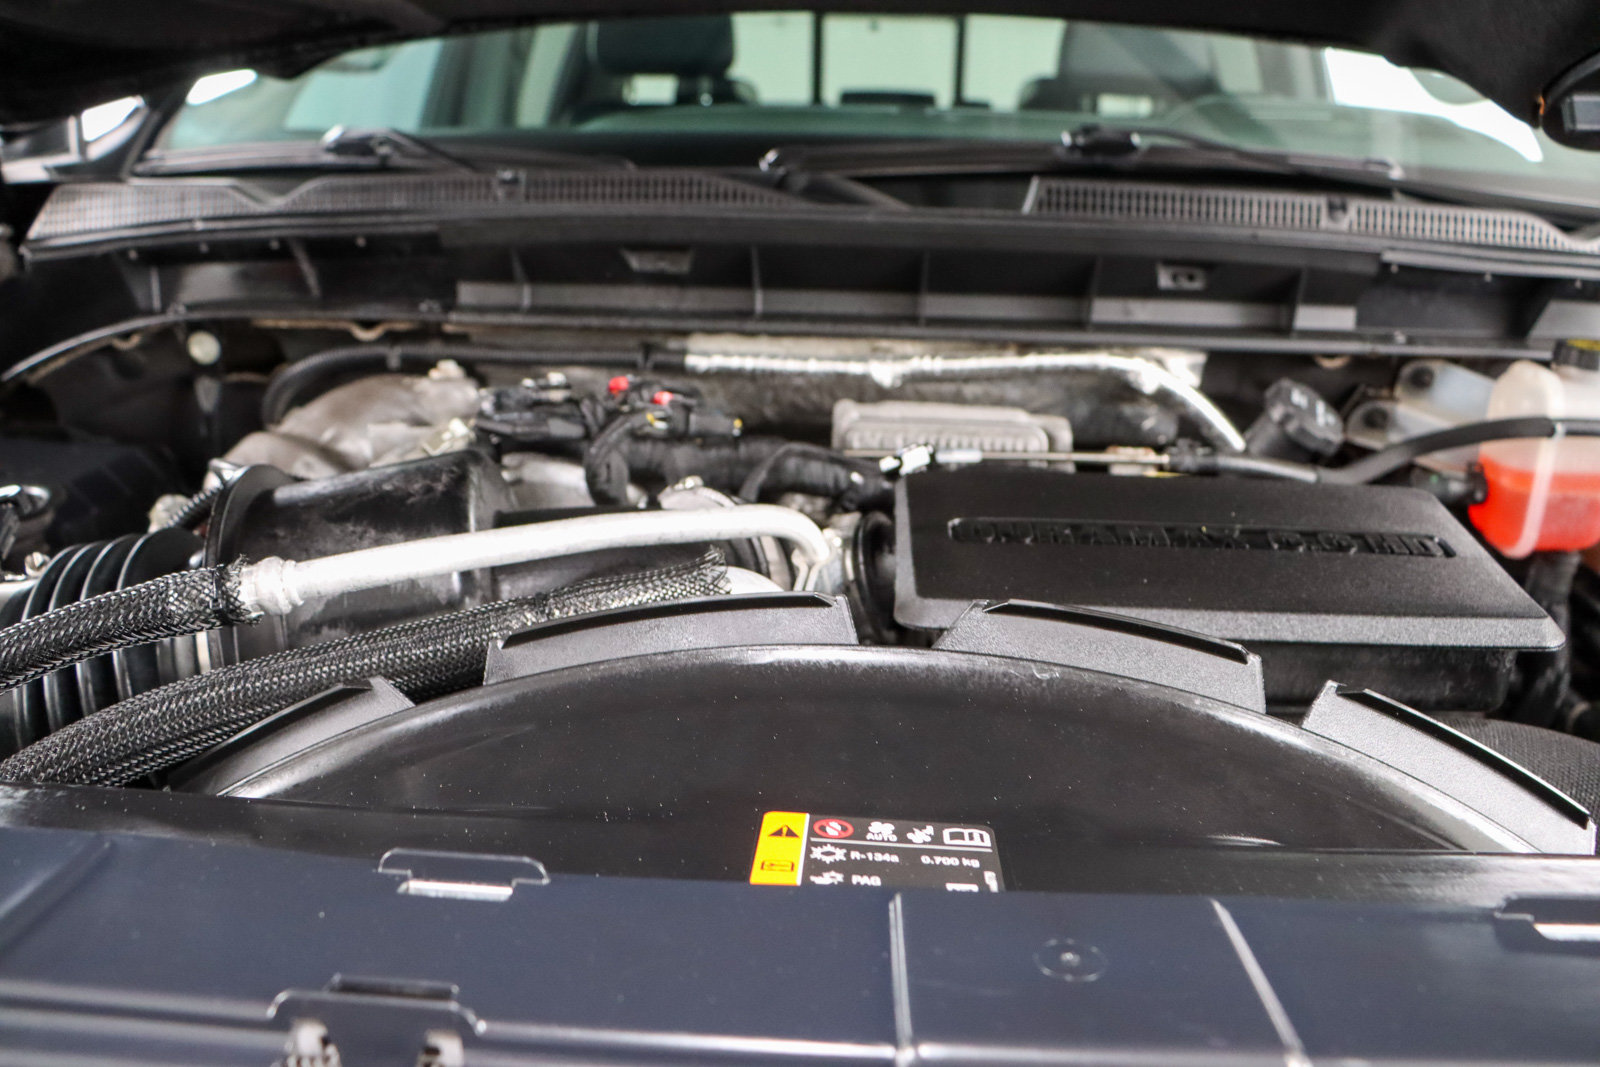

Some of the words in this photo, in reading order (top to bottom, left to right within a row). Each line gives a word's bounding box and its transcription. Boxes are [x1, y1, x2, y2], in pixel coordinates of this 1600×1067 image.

[865, 832, 898, 842] AUTO
[850, 850, 900, 863] R-134a
[920, 854, 960, 866] 0.700
[961, 856, 980, 869] kg
[851, 874, 882, 887] PAG
